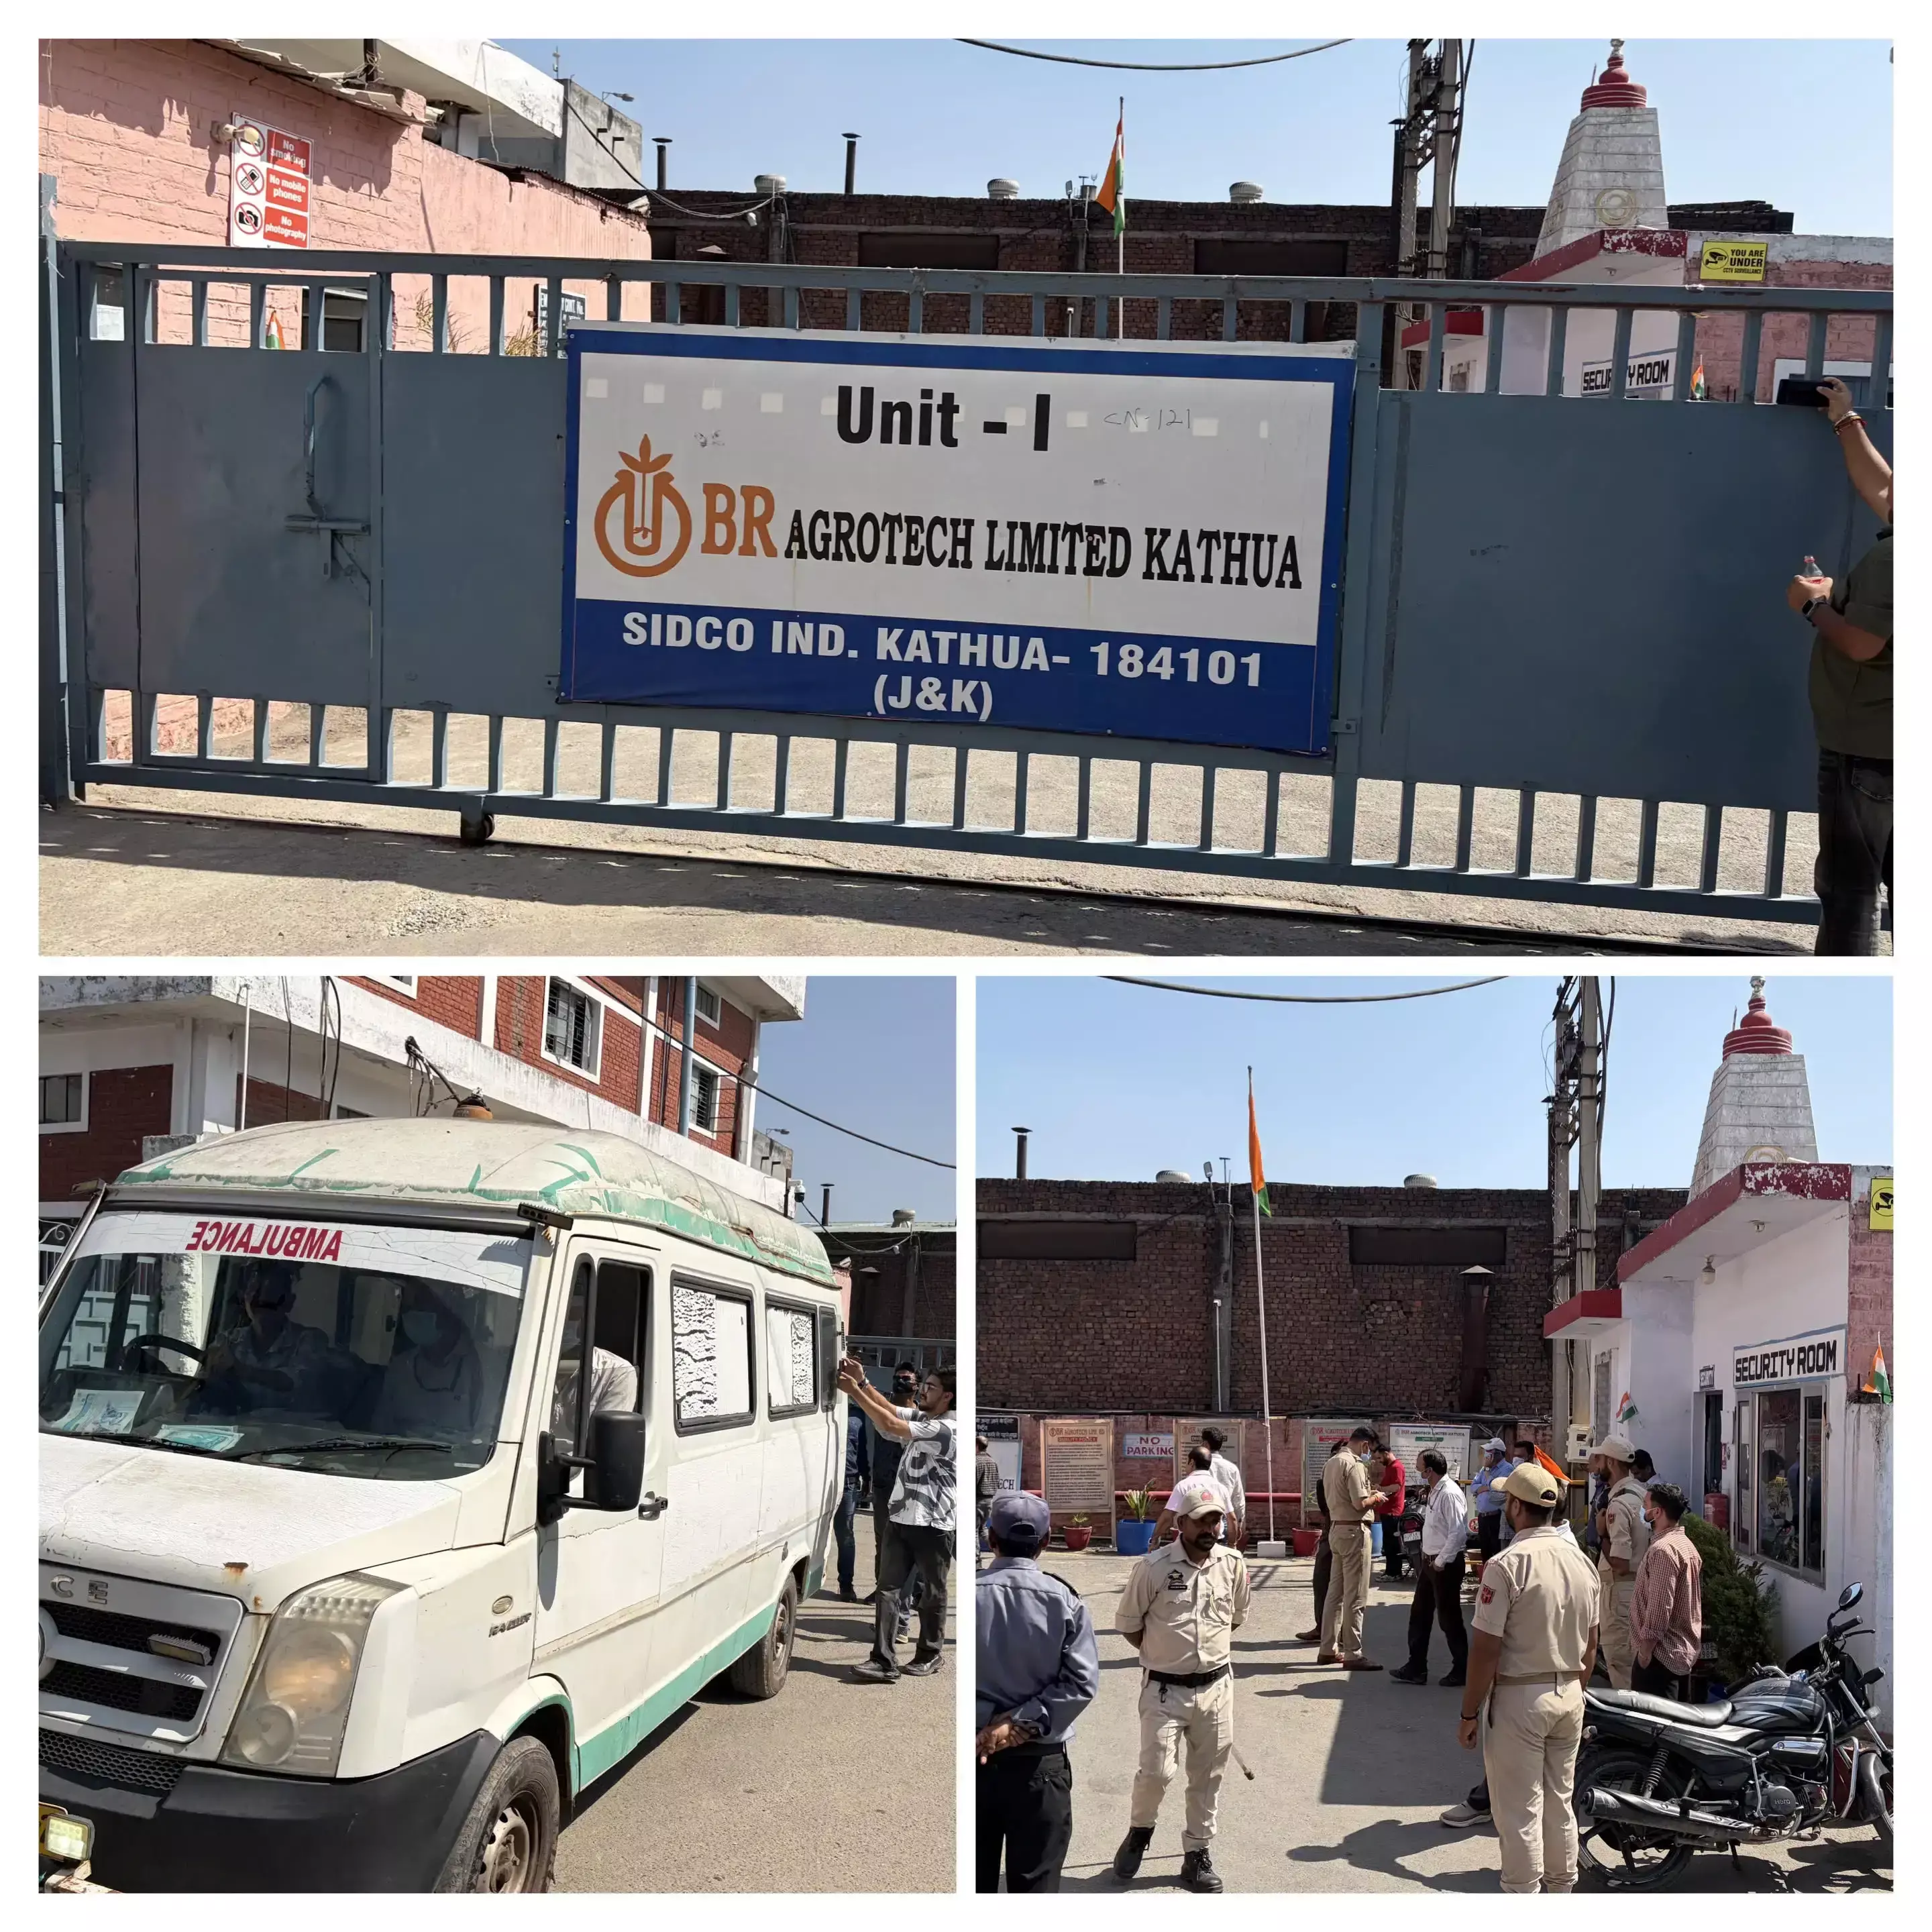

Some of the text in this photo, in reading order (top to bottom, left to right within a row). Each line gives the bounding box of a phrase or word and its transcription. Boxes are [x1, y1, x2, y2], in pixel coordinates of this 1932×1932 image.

[283, 140, 294, 150] No
[271, 148, 306, 168] smoking
[270, 174, 306, 193] No mobile
[274, 188, 302, 203] phones
[281, 215, 292, 226] No
[265, 223, 306, 241] photography
[1730, 258, 1763, 267] UNDER
[1637, 360, 1669, 386] ROOM
[838, 386, 959, 447] Unit
[983, 421, 1008, 434] -
[701, 484, 1303, 590] BR AGROTECH LIMITED KATHUA
[623, 612, 1261, 687] SIDCO IND. KATHUA- 184101
[874, 674, 993, 722] (J&K)
[1735, 1340, 1837, 1383] SECURITY ROOM
[1127, 1447, 1174, 1455] PARKING
